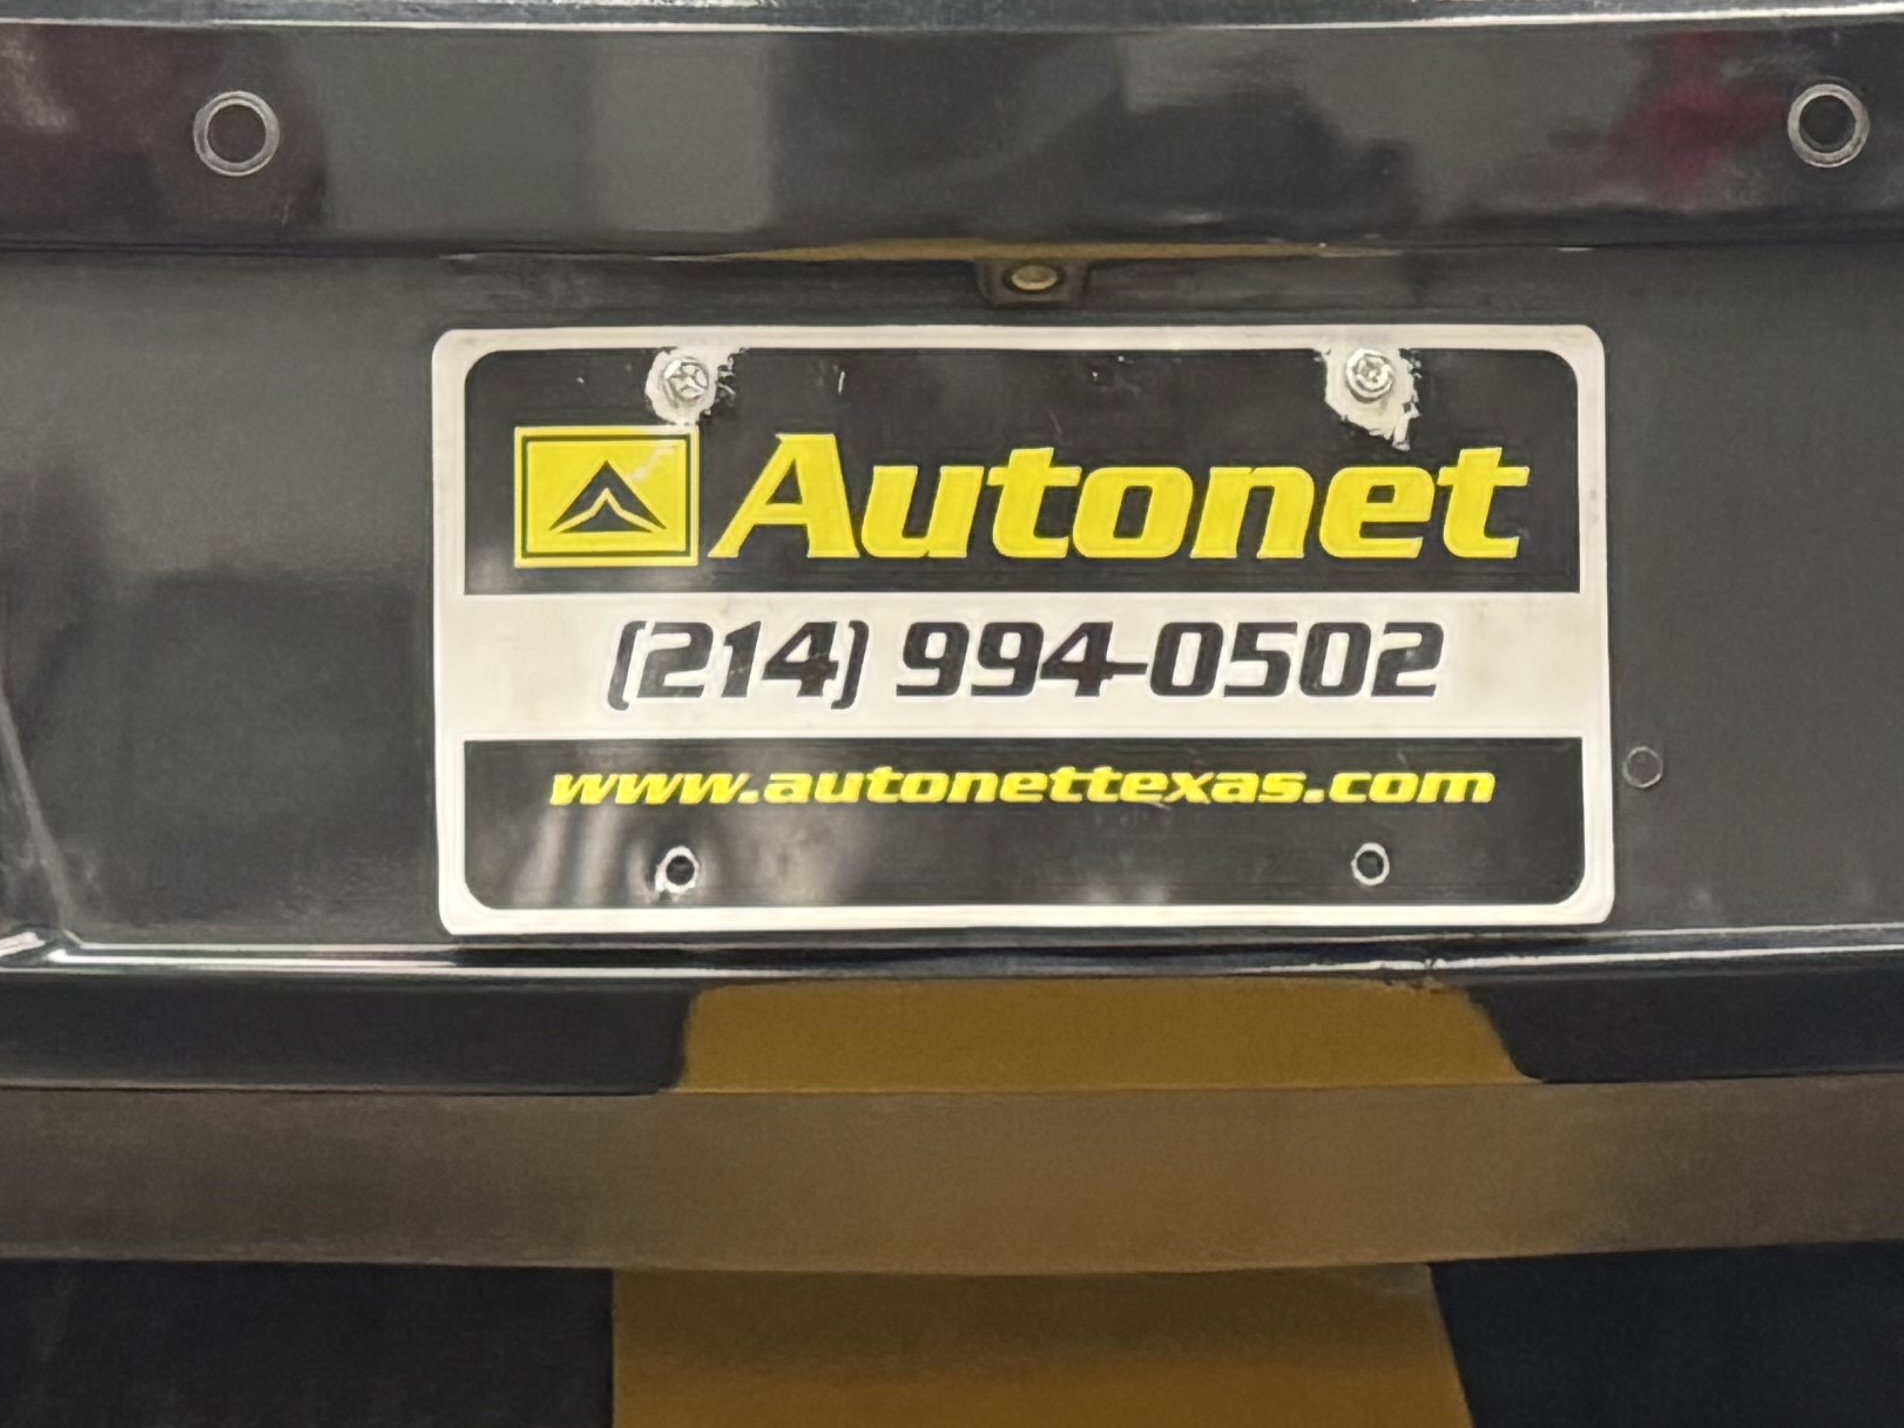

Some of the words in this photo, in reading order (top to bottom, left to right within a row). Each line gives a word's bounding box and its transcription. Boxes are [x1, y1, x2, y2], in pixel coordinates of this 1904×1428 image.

[706, 431, 1531, 560] Autonet
[607, 618, 871, 711] (214)
[896, 619, 1446, 698] 994-0502
[548, 766, 1498, 807] www.autonettexas.com
